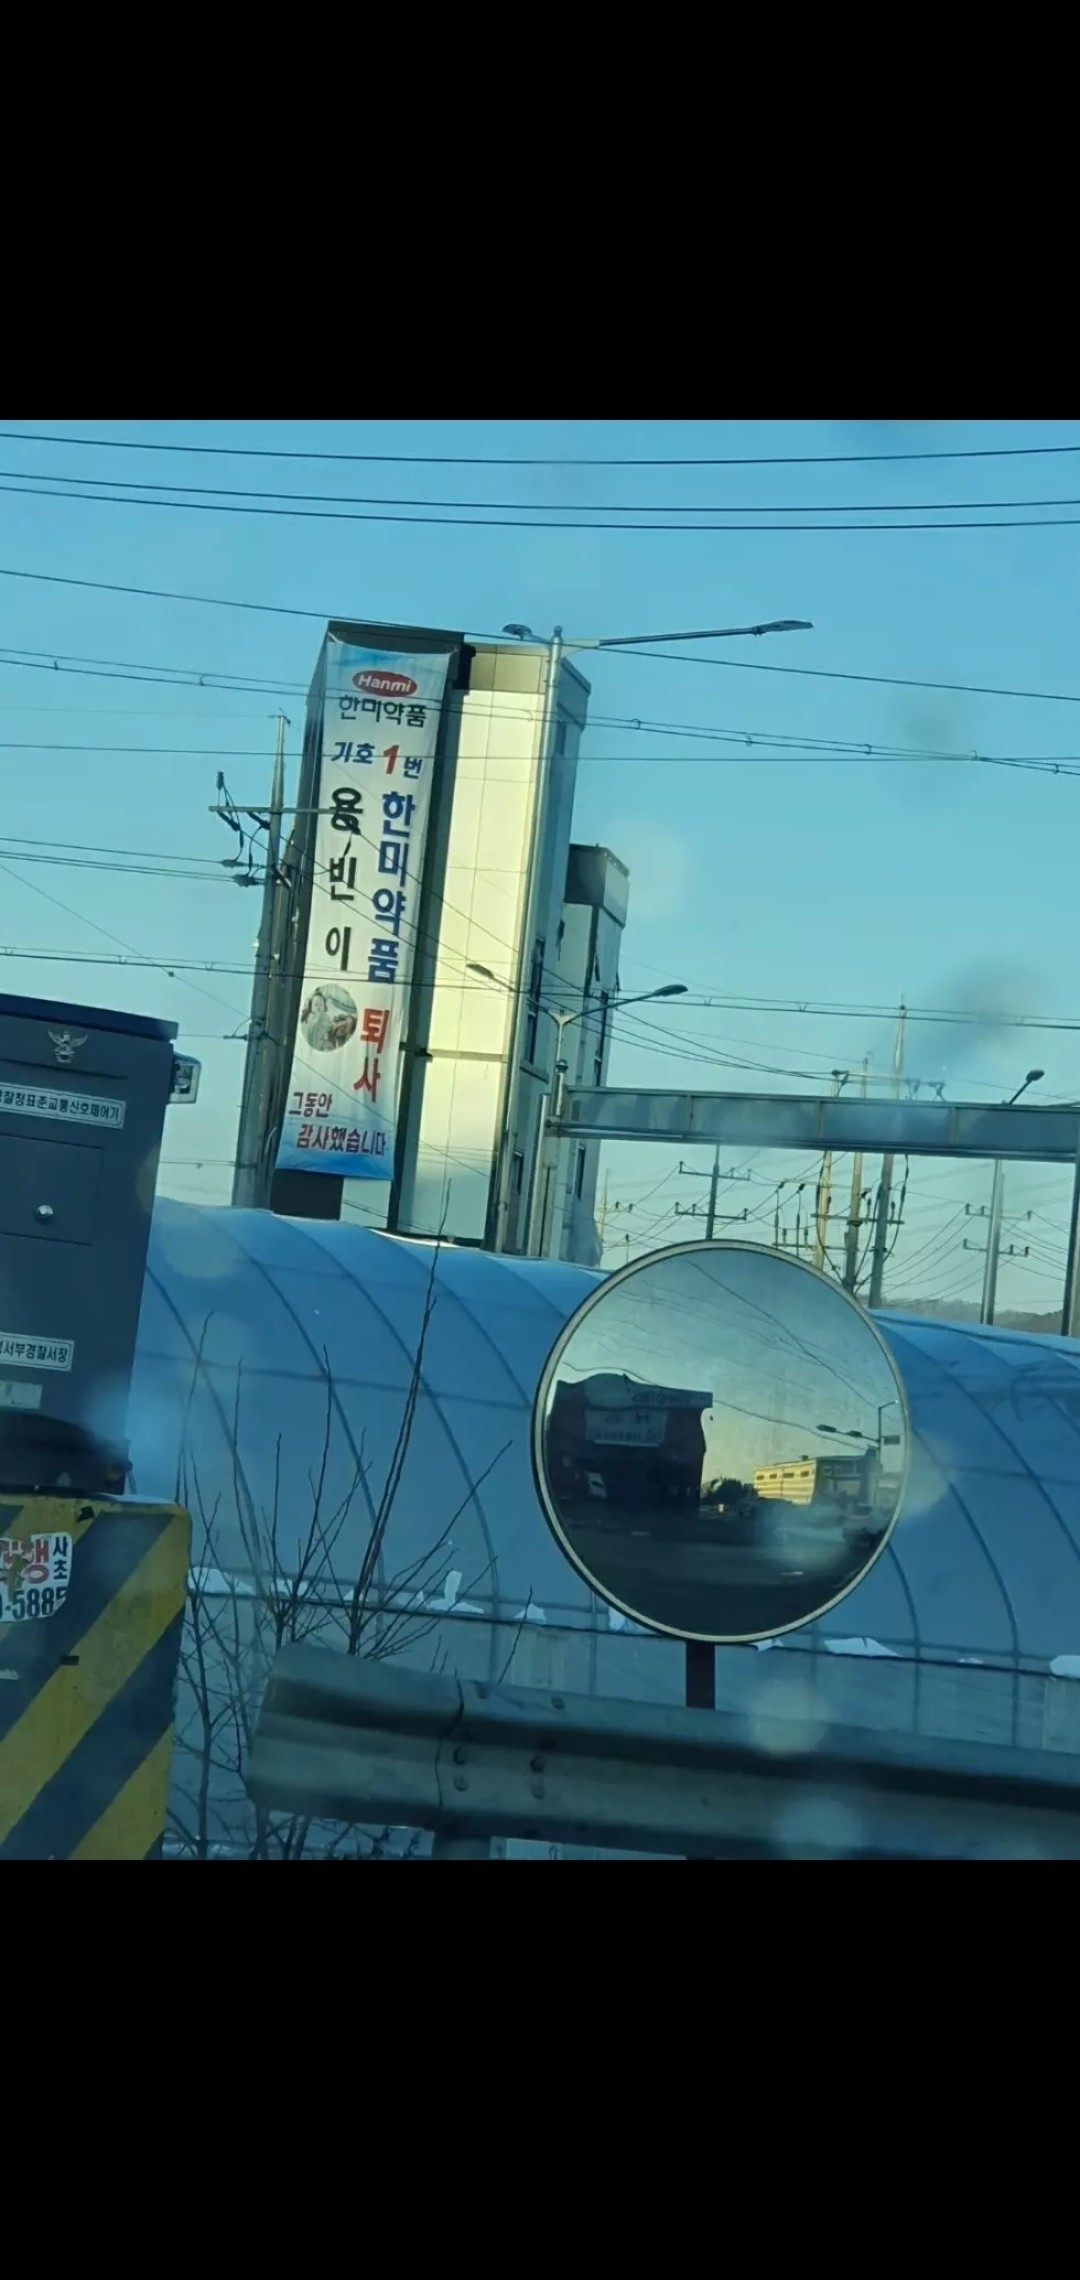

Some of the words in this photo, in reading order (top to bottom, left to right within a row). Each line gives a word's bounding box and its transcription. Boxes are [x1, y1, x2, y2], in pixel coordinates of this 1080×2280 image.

[357, 673, 412, 694] Hanmi
[338, 694, 427, 728] 한미약품
[330, 742, 376, 765] 기호
[382, 744, 400, 775] 1
[403, 756, 423, 779] 번
[368, 789, 415, 983] 한미약품
[352, 1008, 392, 1104] 퇴사
[0, 1089, 120, 1121] 찰청표준교통신호제어기
[288, 1091, 333, 1118] 그동안
[296, 1123, 387, 1157] 감사했습니다
